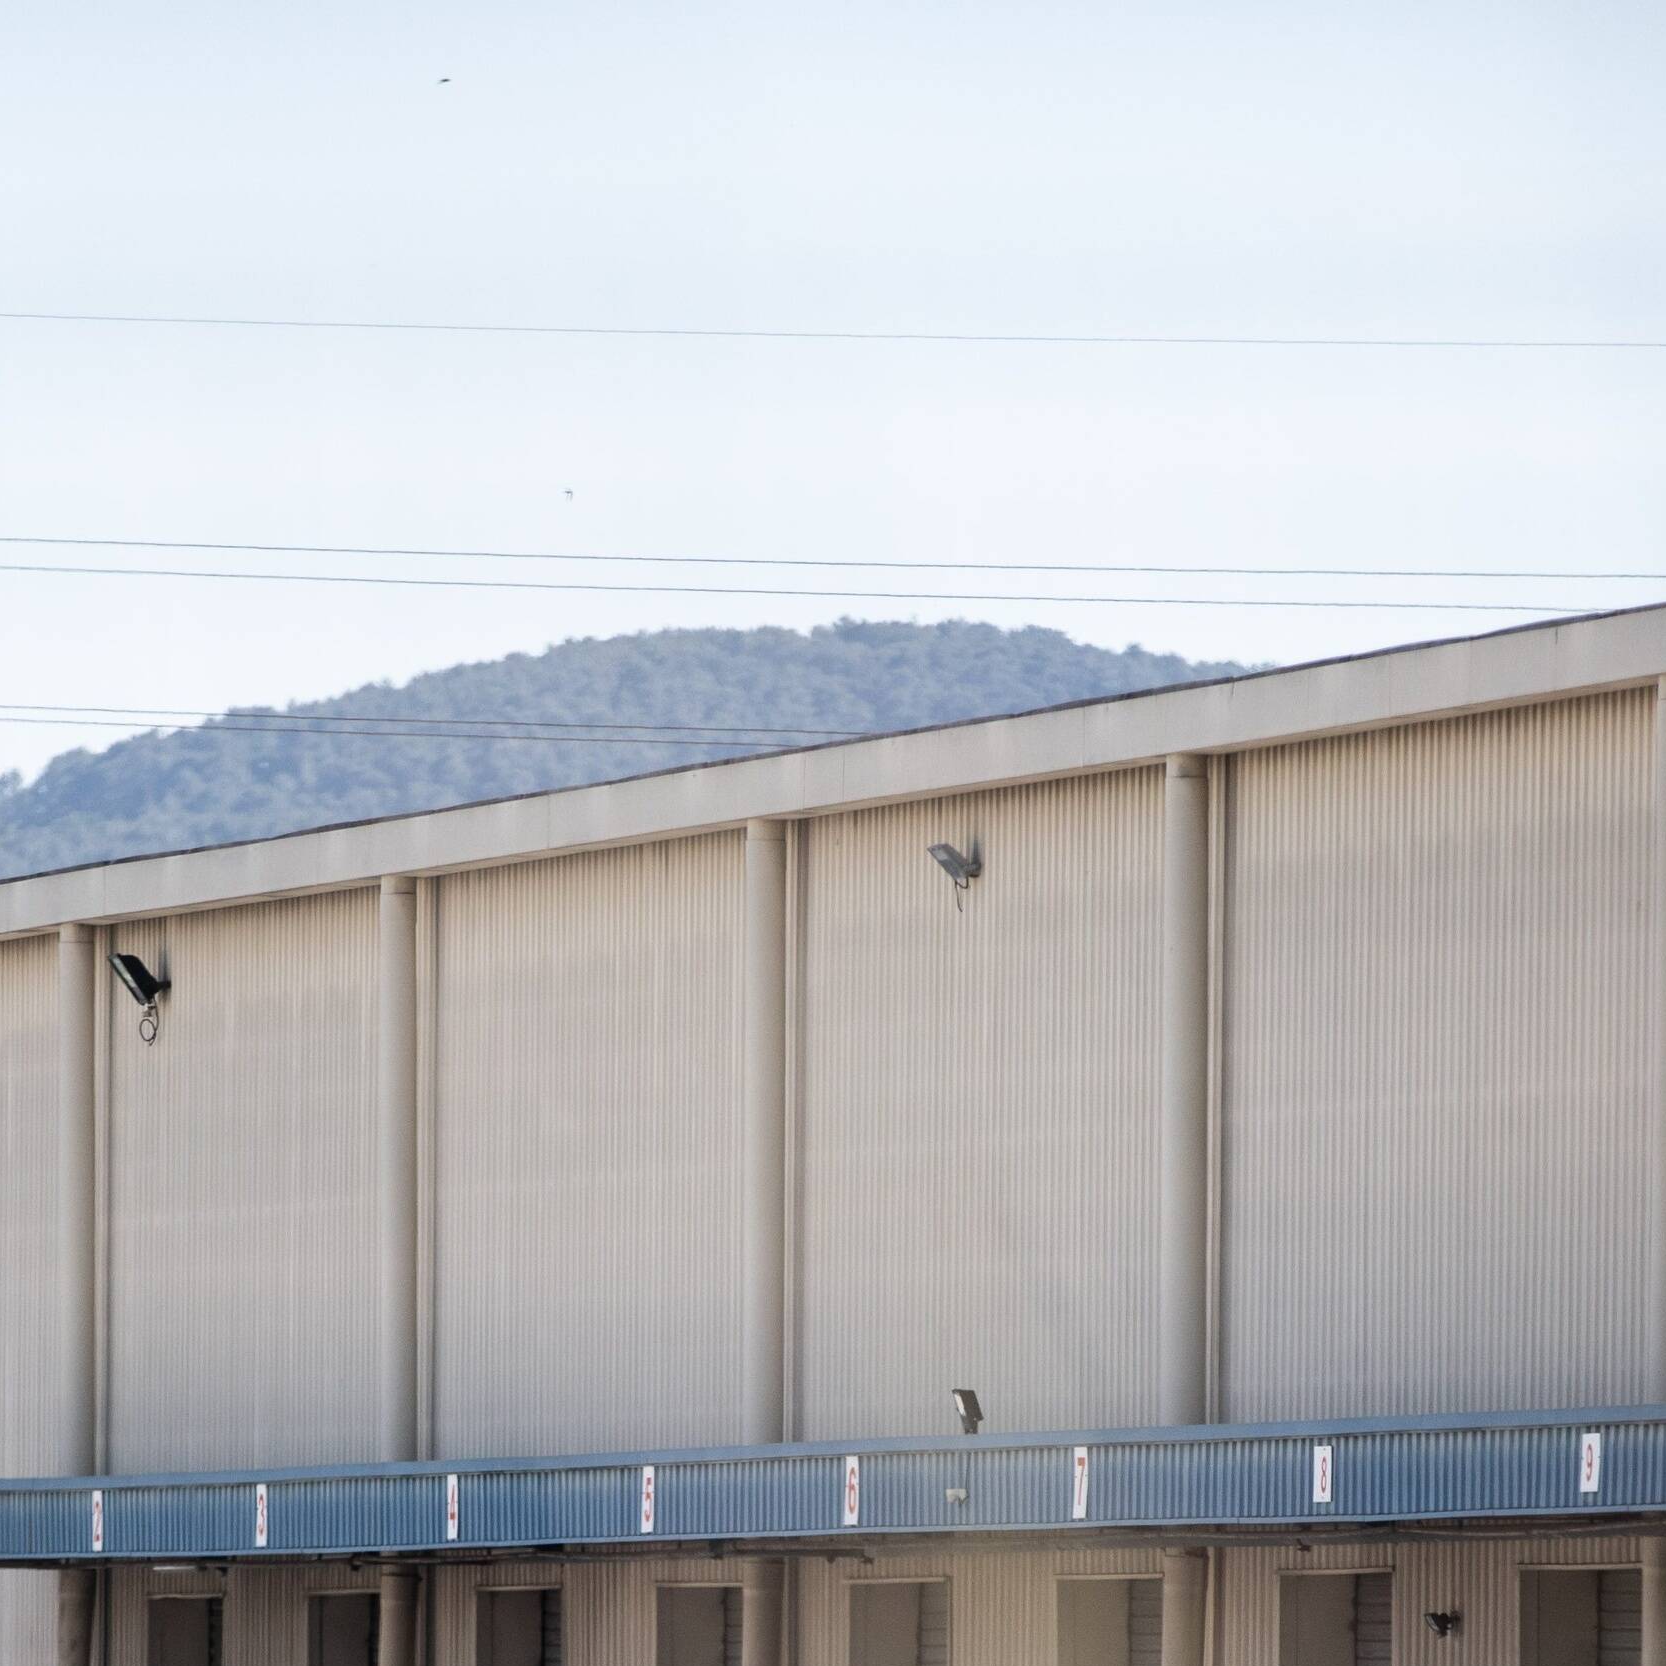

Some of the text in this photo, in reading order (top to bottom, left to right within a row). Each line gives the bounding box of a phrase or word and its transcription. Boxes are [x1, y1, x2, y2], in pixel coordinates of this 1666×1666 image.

[1077, 1457, 1086, 1506] 7
[1320, 1456, 1327, 1493] 8
[1586, 1444, 1593, 1482] 9
[449, 1485, 457, 1529] 4
[645, 1477, 652, 1522] 5
[847, 1467, 857, 1515] 6
[93, 1501, 101, 1542] 2
[258, 1494, 265, 1536] 3
